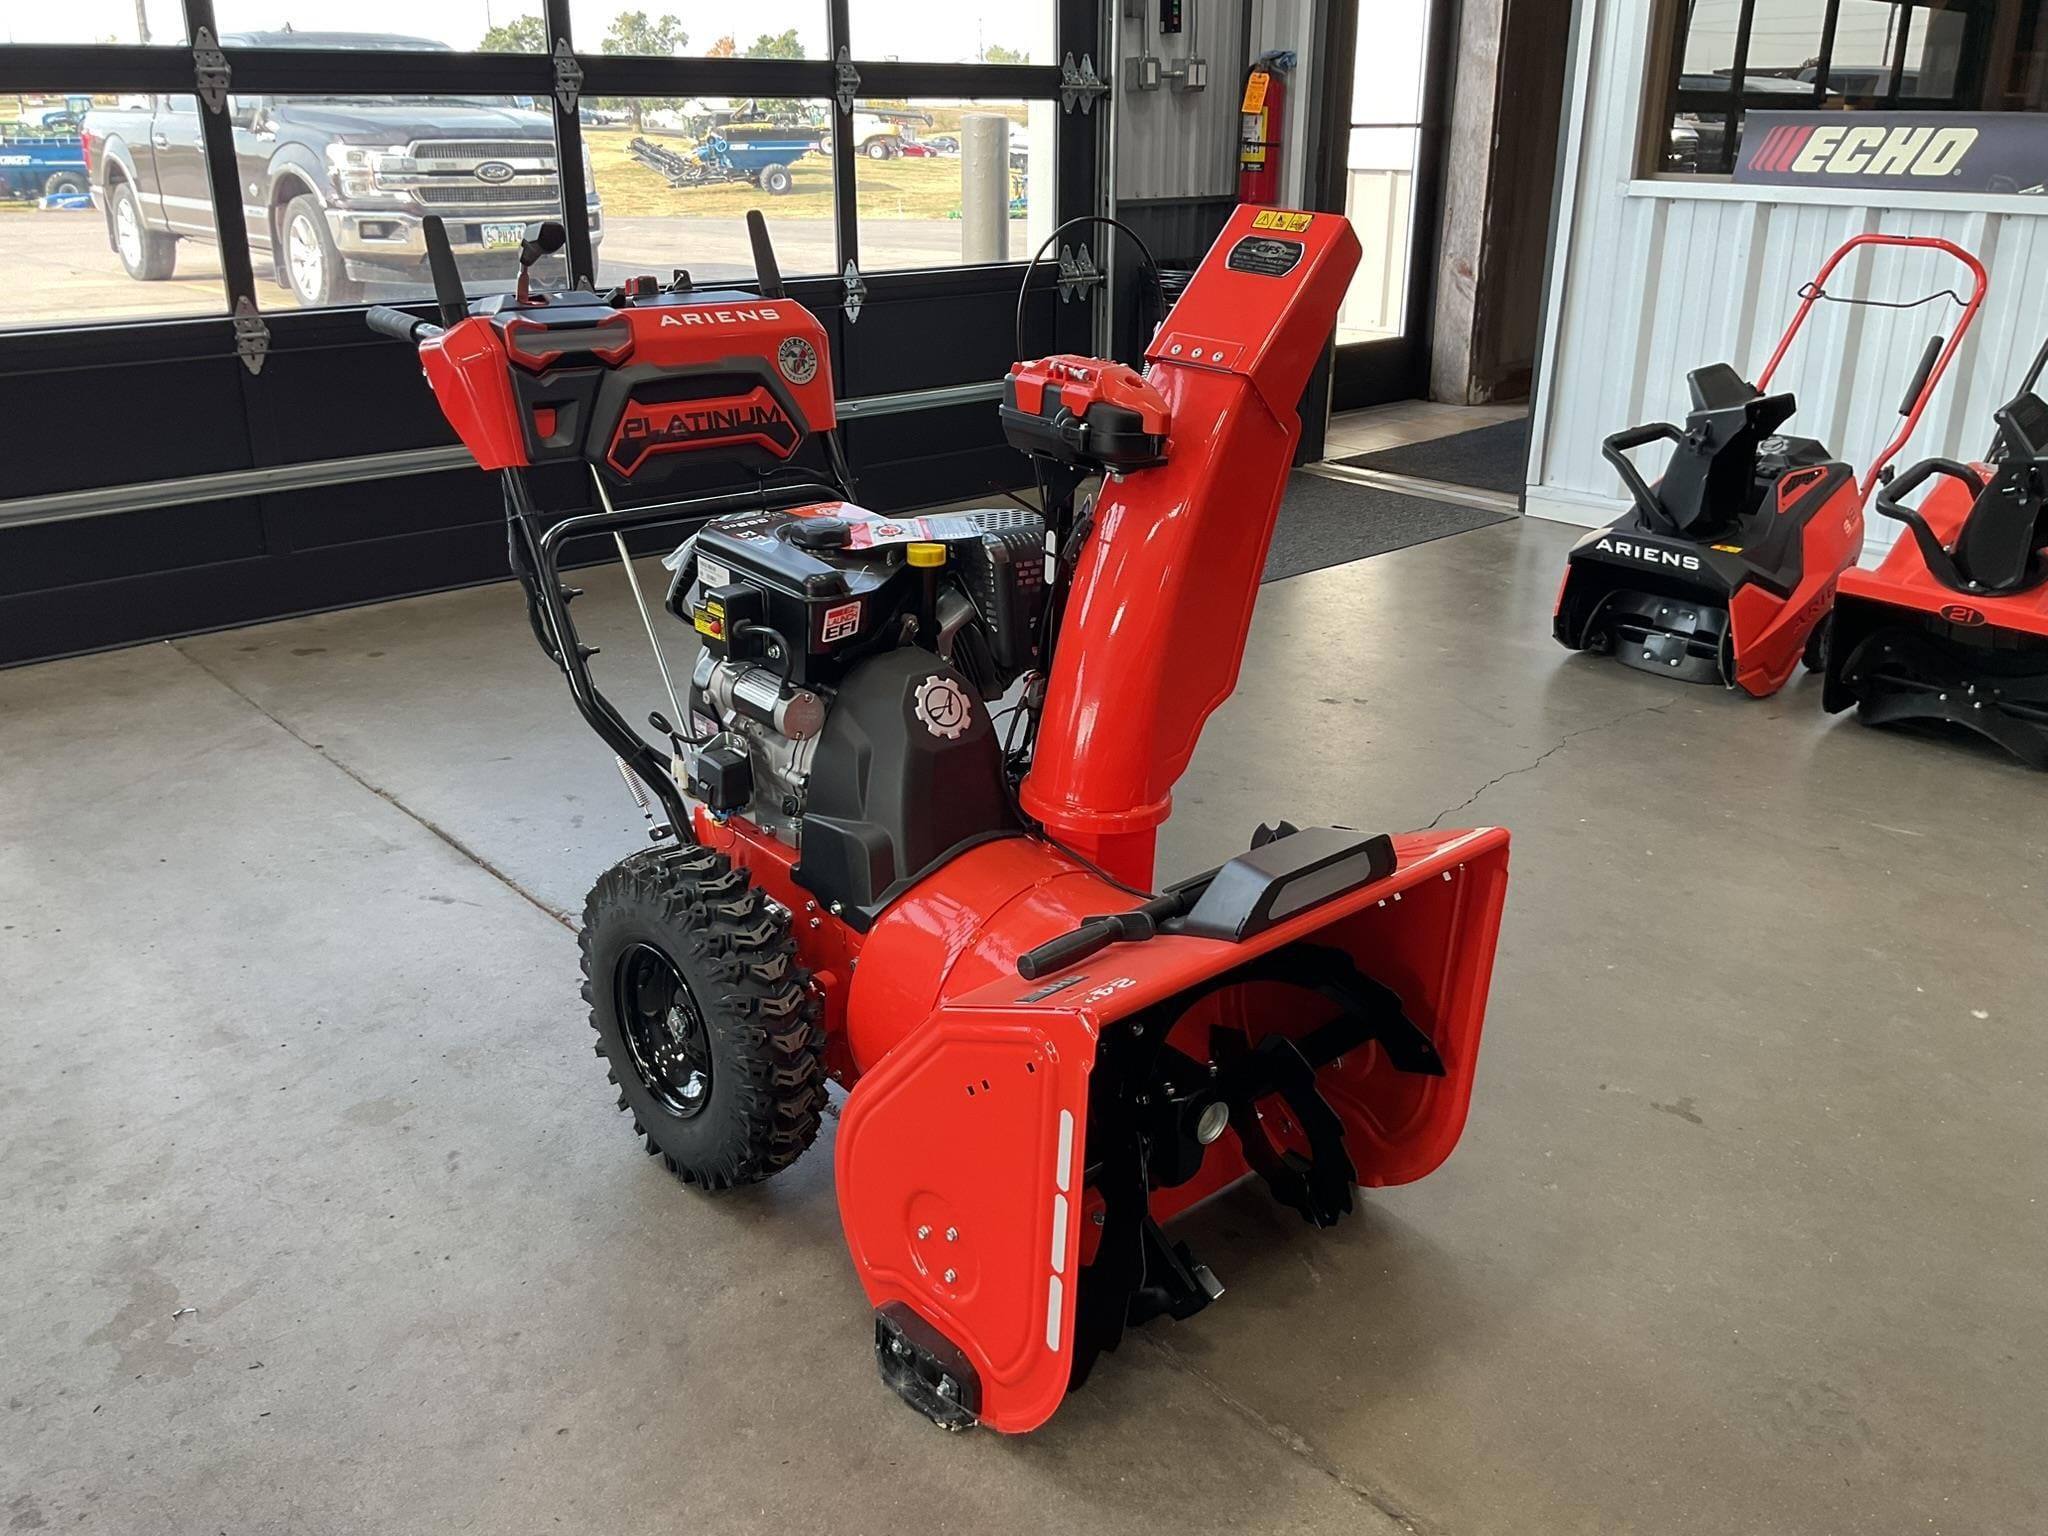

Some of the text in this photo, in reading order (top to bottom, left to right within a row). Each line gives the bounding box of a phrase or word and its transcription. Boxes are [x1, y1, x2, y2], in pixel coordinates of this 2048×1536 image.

[1791, 126, 1979, 176] ECHO
[660, 308, 780, 328] ARIENS
[622, 405, 781, 440] PLATINUM
[1595, 538, 1700, 571] ARIENS
[1949, 607, 1975, 623] 21
[825, 620, 857, 640] EFI
